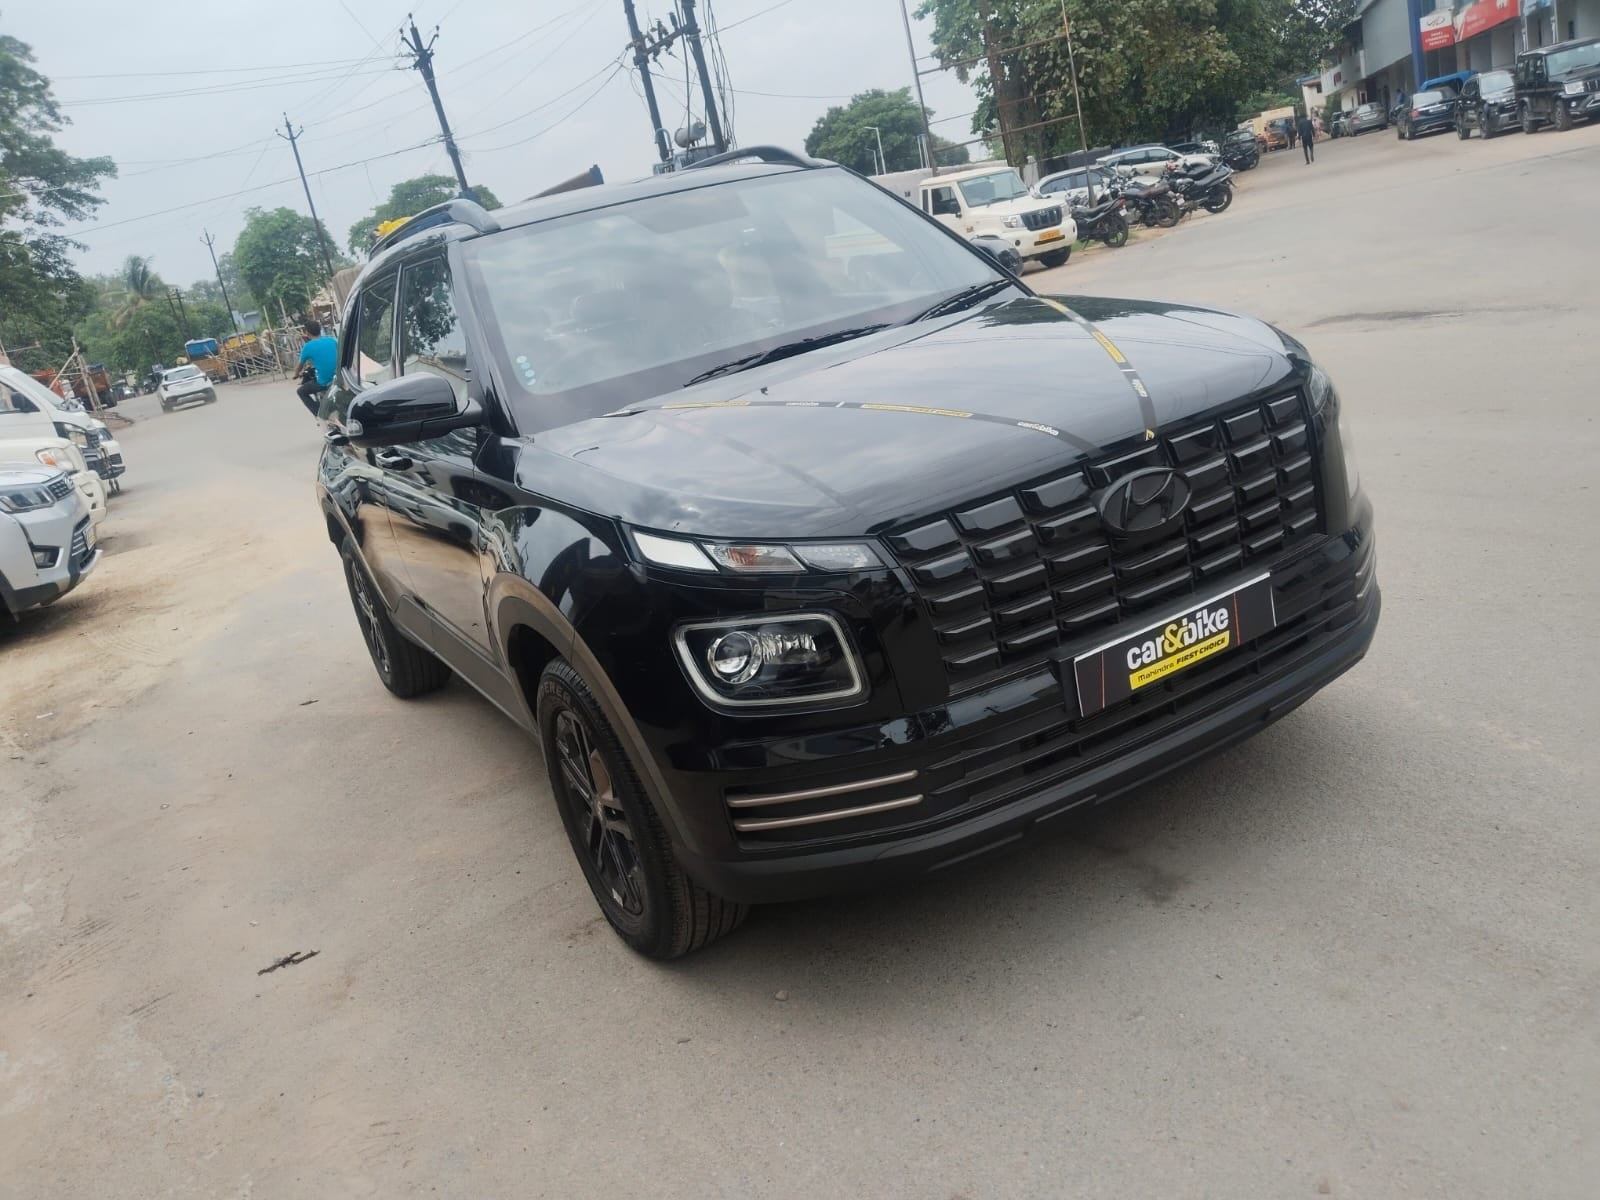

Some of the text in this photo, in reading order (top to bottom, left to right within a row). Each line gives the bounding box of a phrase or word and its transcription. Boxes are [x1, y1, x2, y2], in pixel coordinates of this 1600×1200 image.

[1127, 607, 1229, 670] car&bike
[1176, 650, 1198, 664] FIRST
[1199, 637, 1225, 654] CHOICE
